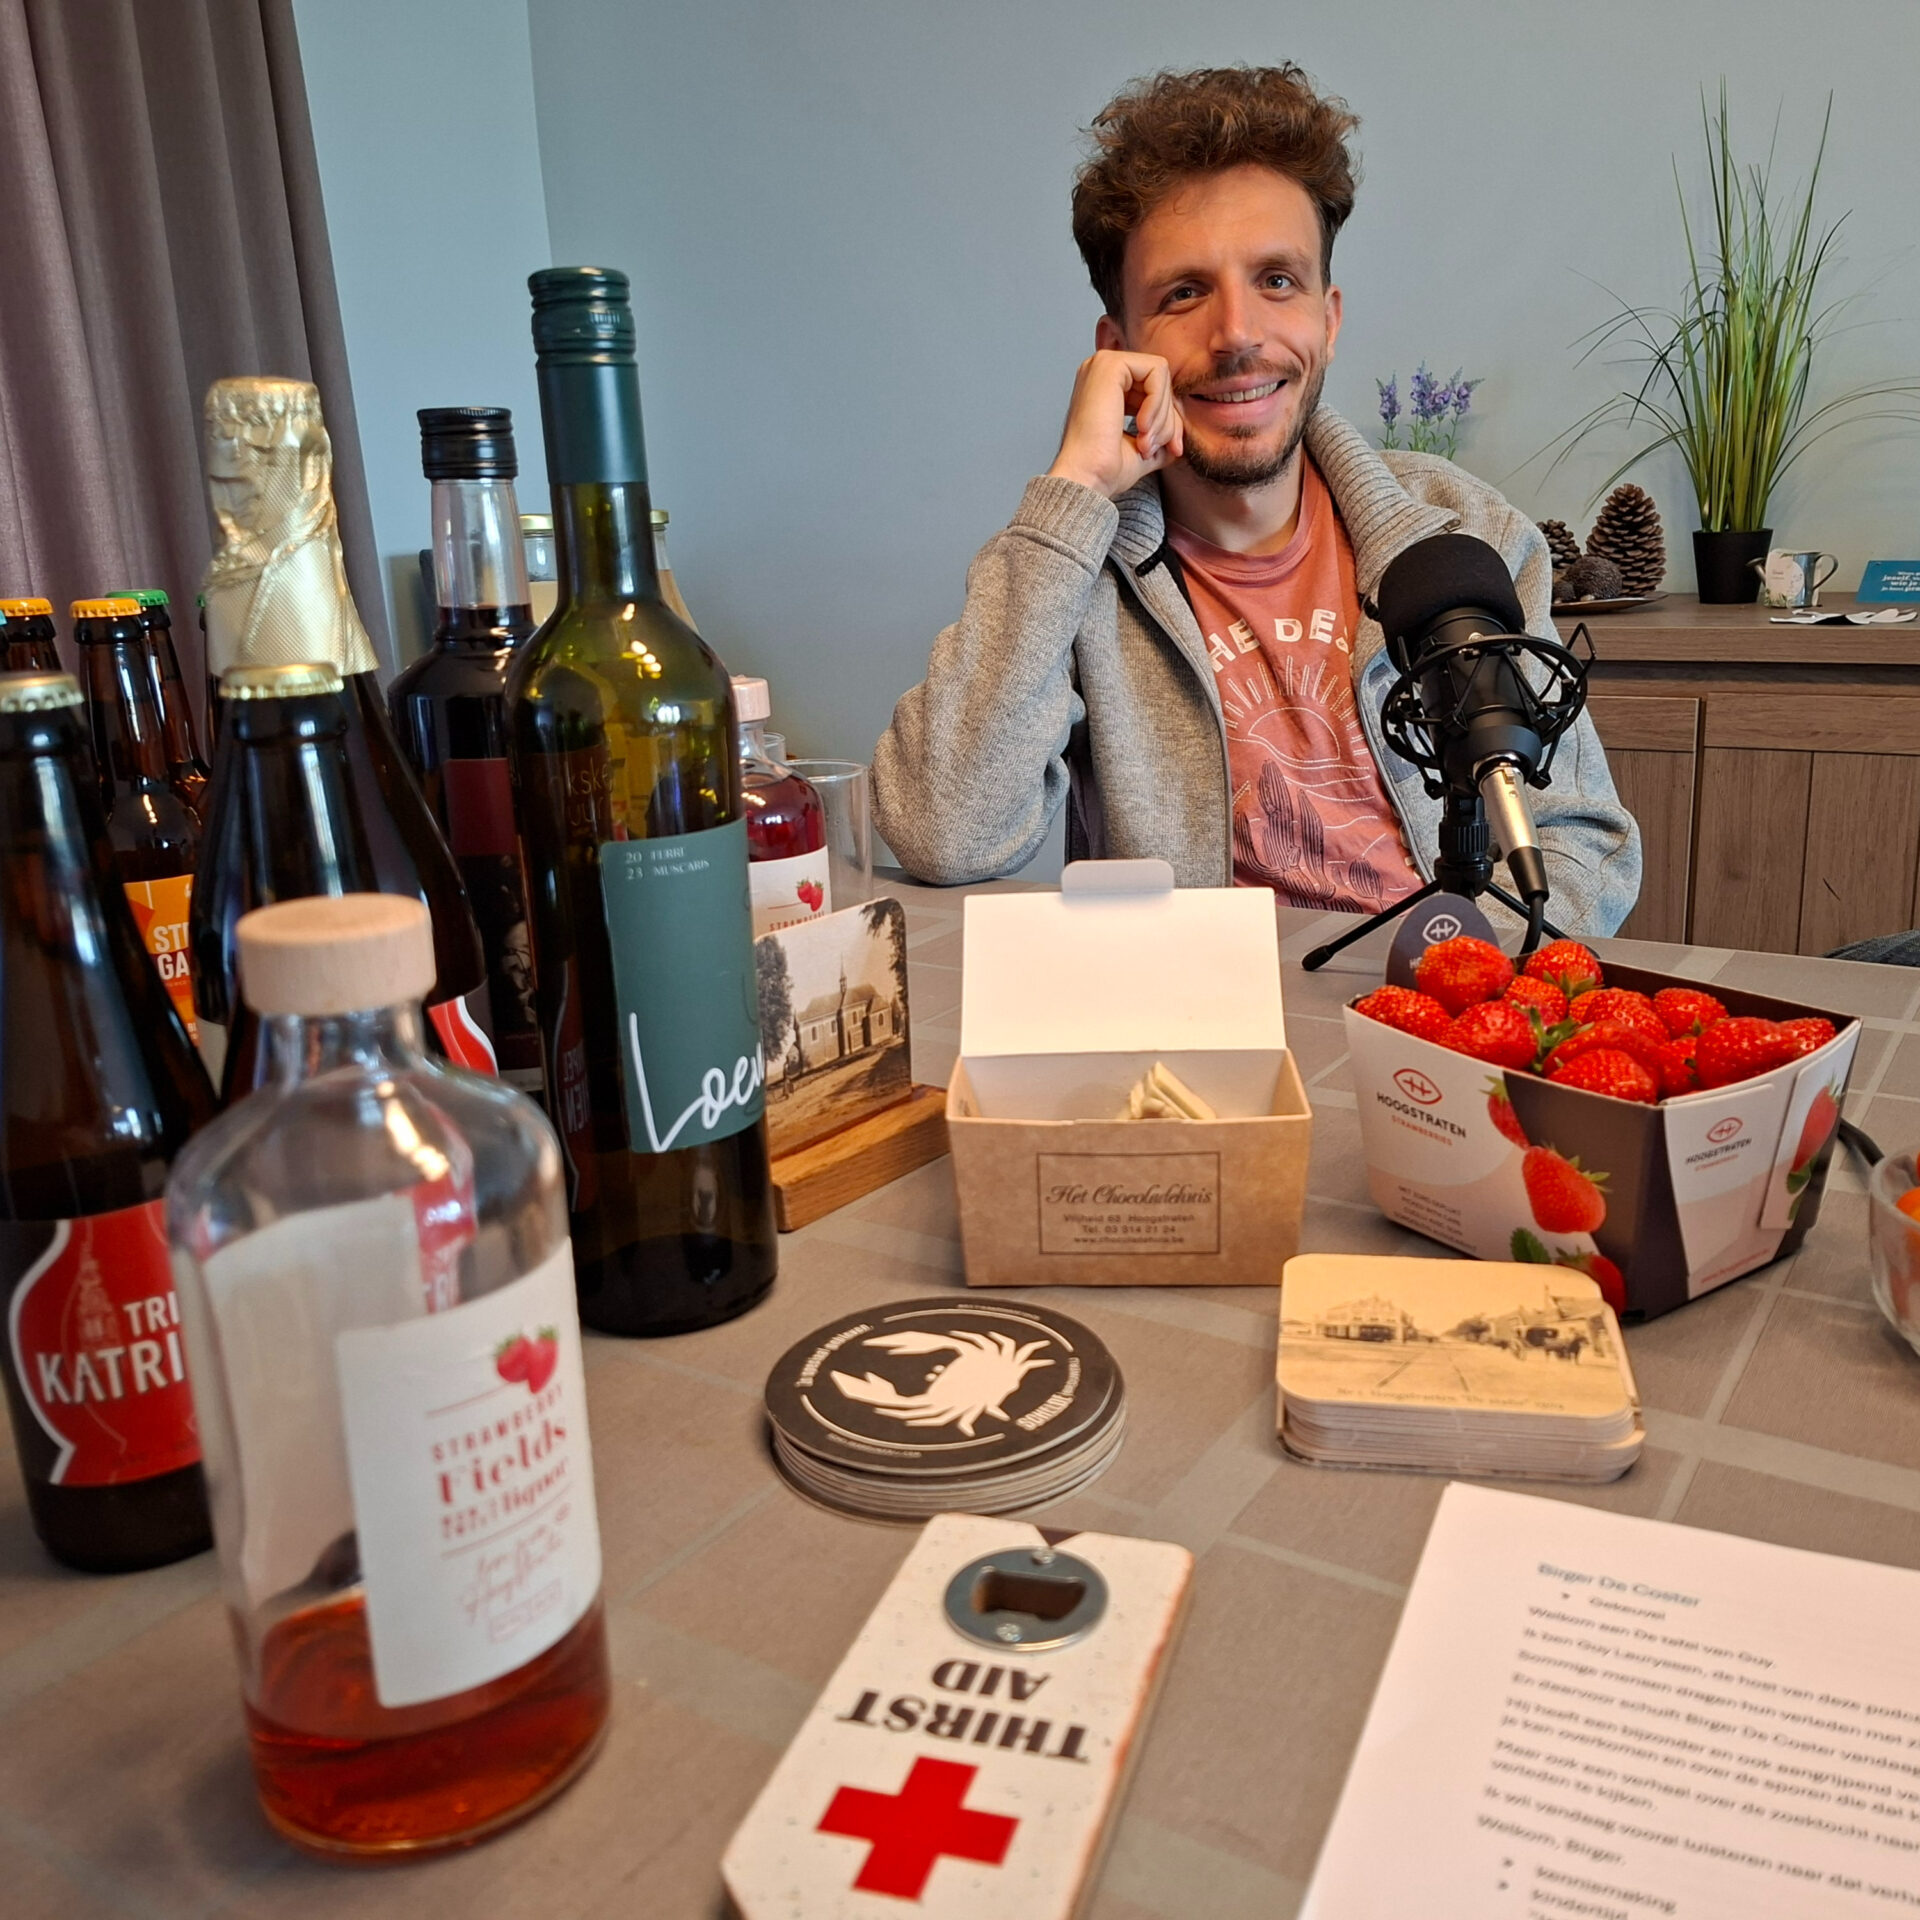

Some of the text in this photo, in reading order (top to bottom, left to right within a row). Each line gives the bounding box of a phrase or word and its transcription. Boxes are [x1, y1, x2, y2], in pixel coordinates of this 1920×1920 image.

[1376, 1092, 1467, 1138] HOOGSTRATEN
[1686, 1138, 1753, 1164] HOOGSTRATEN
[1045, 1183, 1213, 1205] Het Chocoladehuis
[431, 1380, 563, 1463] STRAWBERRY
[438, 1417, 567, 1504] Fields
[1538, 1563, 1701, 1607] Birger De Coster
[1523, 1627, 1537, 1638] Ik
[1541, 1632, 1574, 1646] ben
[1576, 1640, 1611, 1656] Guy
[1712, 1671, 1734, 1682] de
[1738, 1675, 1777, 1692] host
[1783, 1686, 1815, 1701] van
[1818, 1694, 1861, 1710] deze
[1529, 1606, 1596, 1628] Welkom
[1599, 1622, 1630, 1636] aan
[1634, 1629, 1658, 1642] De
[1661, 1636, 1700, 1651] tafel
[1702, 1645, 1734, 1659] van
[930, 1657, 1051, 1703] AID
[1512, 1672, 1536, 1686] En
[1538, 1680, 1615, 1704] daarvoor
[1619, 1699, 1681, 1719] schuift
[1685, 1713, 1737, 1733] Birger
[1742, 1726, 1769, 1741] De
[1773, 1734, 1835, 1757] Coster
[1518, 1649, 1598, 1676] Sommige
[1602, 1670, 1673, 1693] mensen
[1676, 1686, 1737, 1709] dragen
[1741, 1700, 1777, 1717] hun
[1781, 1711, 1862, 1736] verleden
[1865, 1729, 1902, 1744] met
[835, 1687, 1090, 1764] THIRST
[1506, 1697, 1531, 1714] Hij
[1534, 1703, 1580, 1721] heeft
[1584, 1716, 1618, 1731] een
[1621, 1725, 1704, 1753] bijzonder
[1709, 1748, 1733, 1760] en
[1737, 1754, 1772, 1769] ook
[1491, 1760, 1571, 1788] verleden
[1574, 1780, 1593, 1793] te
[1496, 1739, 1541, 1759] Maar
[1544, 1753, 1578, 1769] ook
[1582, 1764, 1618, 1779] een
[1621, 1773, 1691, 1798] verhaal
[1696, 1793, 1736, 1809] over
[1741, 1802, 1766, 1816] de
[1770, 1810, 1869, 1839] zoektocht
[1558, 1730, 1659, 1761] overkomen
[1662, 1753, 1687, 1767] en
[1690, 1761, 1730, 1779] over
[1734, 1771, 1760, 1786] de
[1764, 1779, 1832, 1802] sporen
[1836, 1794, 1867, 1810] die
[1484, 1785, 1500, 1798] Ik
[1504, 1792, 1532, 1809] wil
[1535, 1800, 1616, 1834] vandaag
[1619, 1824, 1679, 1847] vooral
[1683, 1836, 1773, 1870] luisteren
[1777, 1861, 1823, 1880] naar
